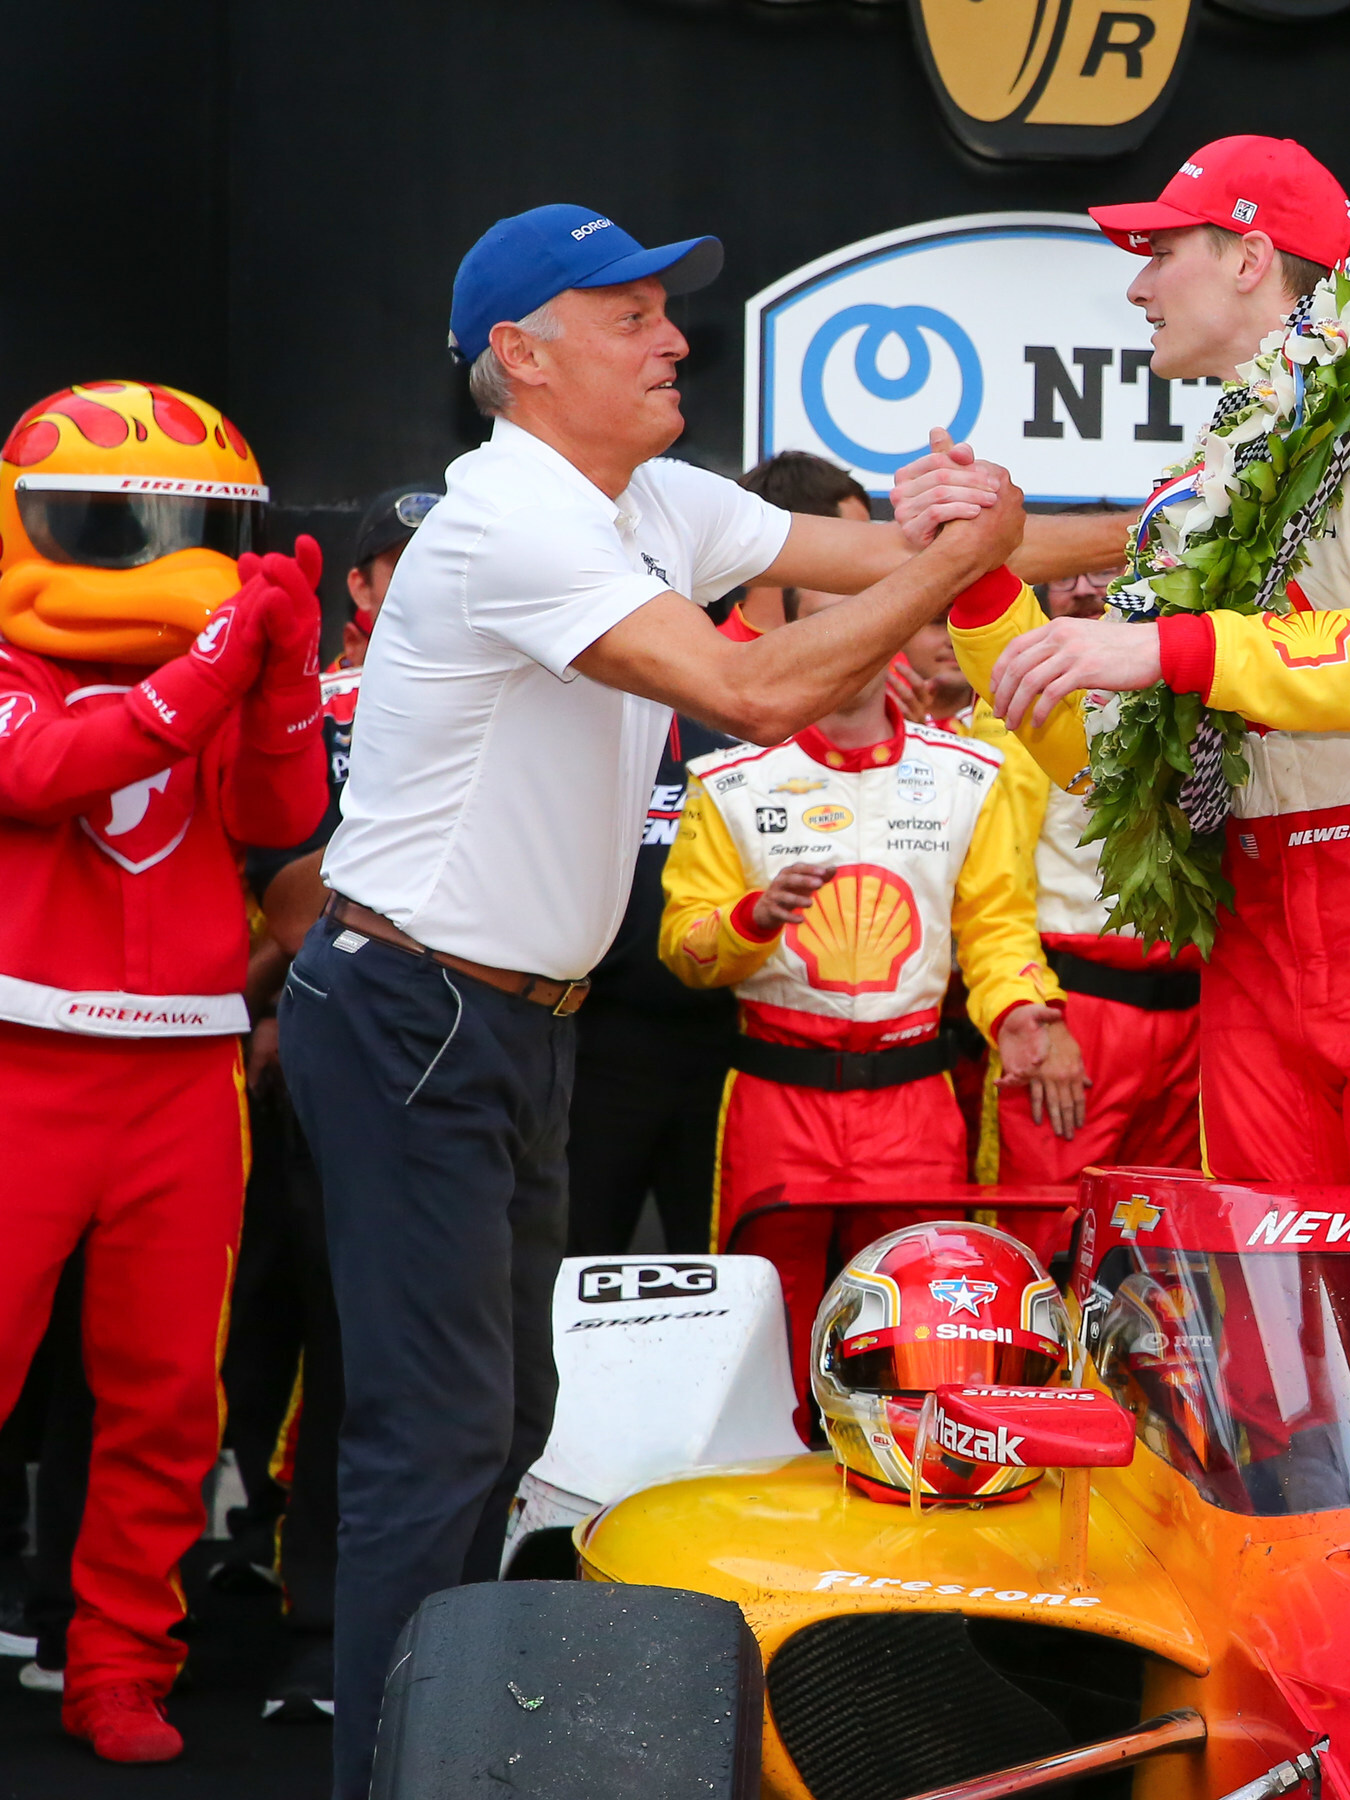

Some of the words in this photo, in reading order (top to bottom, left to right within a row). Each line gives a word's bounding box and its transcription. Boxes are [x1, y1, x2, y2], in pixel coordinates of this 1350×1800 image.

[1079, 14, 1155, 78] R
[1023, 345, 1223, 442] NT
[120, 479, 260, 497] FIREHAWK
[958, 763, 985, 782] OMP
[716, 774, 746, 793] OMP
[757, 809, 787, 833] PPG
[808, 813, 848, 825] PENNZOIL
[887, 817, 942, 831] verizon
[887, 839, 950, 851] HITACHI
[68, 1003, 204, 1026] FIREHAWK
[583, 1265, 713, 1300] PPG
[565, 1309, 731, 1334] Snap-on
[935, 1323, 1013, 1344] Shell
[1173, 1335, 1213, 1348] NTT
[961, 1388, 1097, 1402] SIEMENS
[873, 1435, 890, 1446] BELL
[934, 1406, 1028, 1467] Mazak
[813, 1570, 1102, 1607] Firestone
